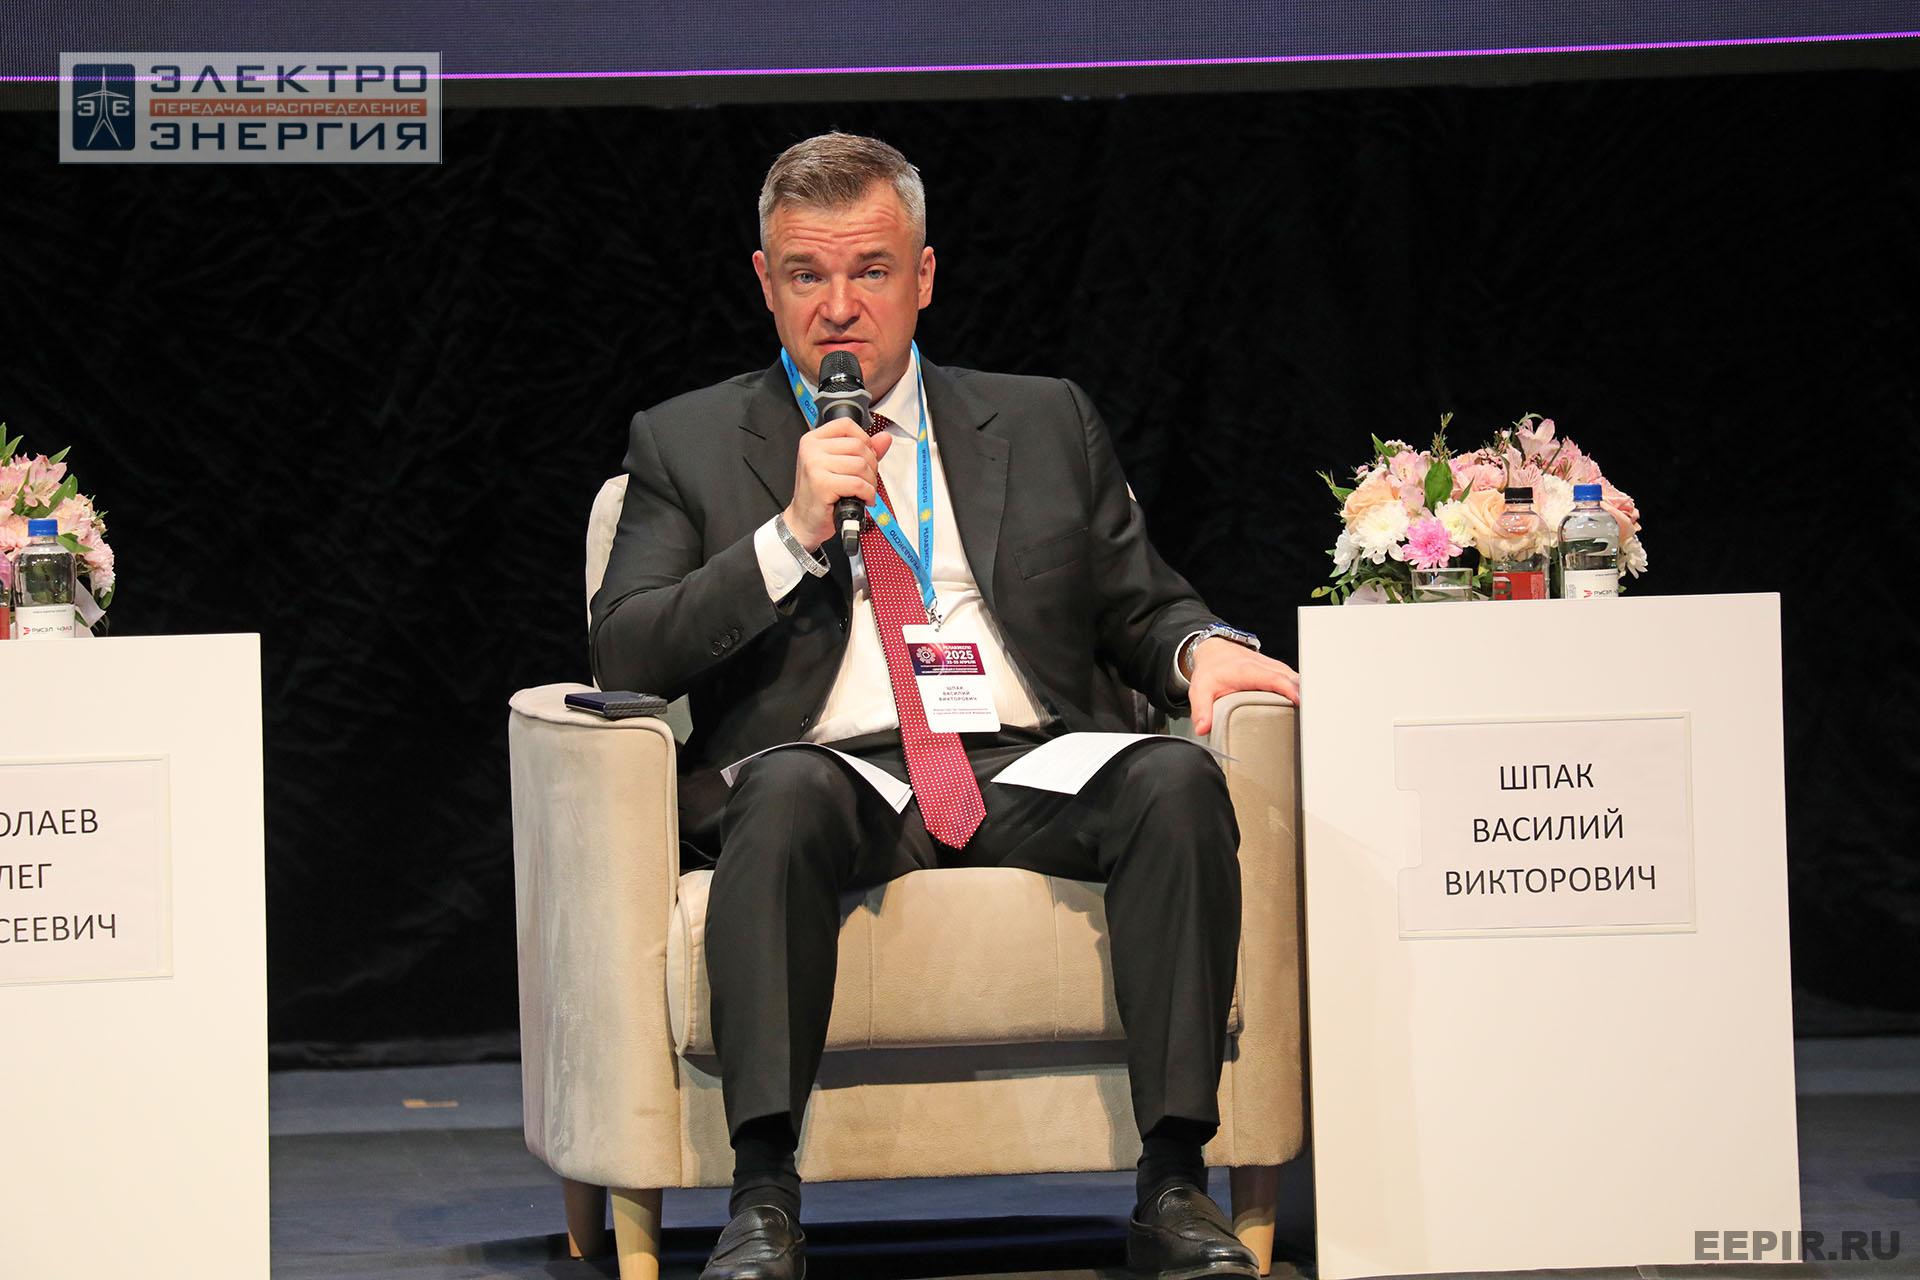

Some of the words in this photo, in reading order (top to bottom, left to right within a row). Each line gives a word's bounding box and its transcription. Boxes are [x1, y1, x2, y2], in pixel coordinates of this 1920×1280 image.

[945, 650, 974, 660] 2025
[1499, 763, 1594, 791] ШПАК
[1472, 807, 1624, 843] ВАСИЛИЙ
[1445, 865, 1657, 896] ВИКТОРОВИЧ
[0, 913, 116, 944] СЕЕВИЧ
